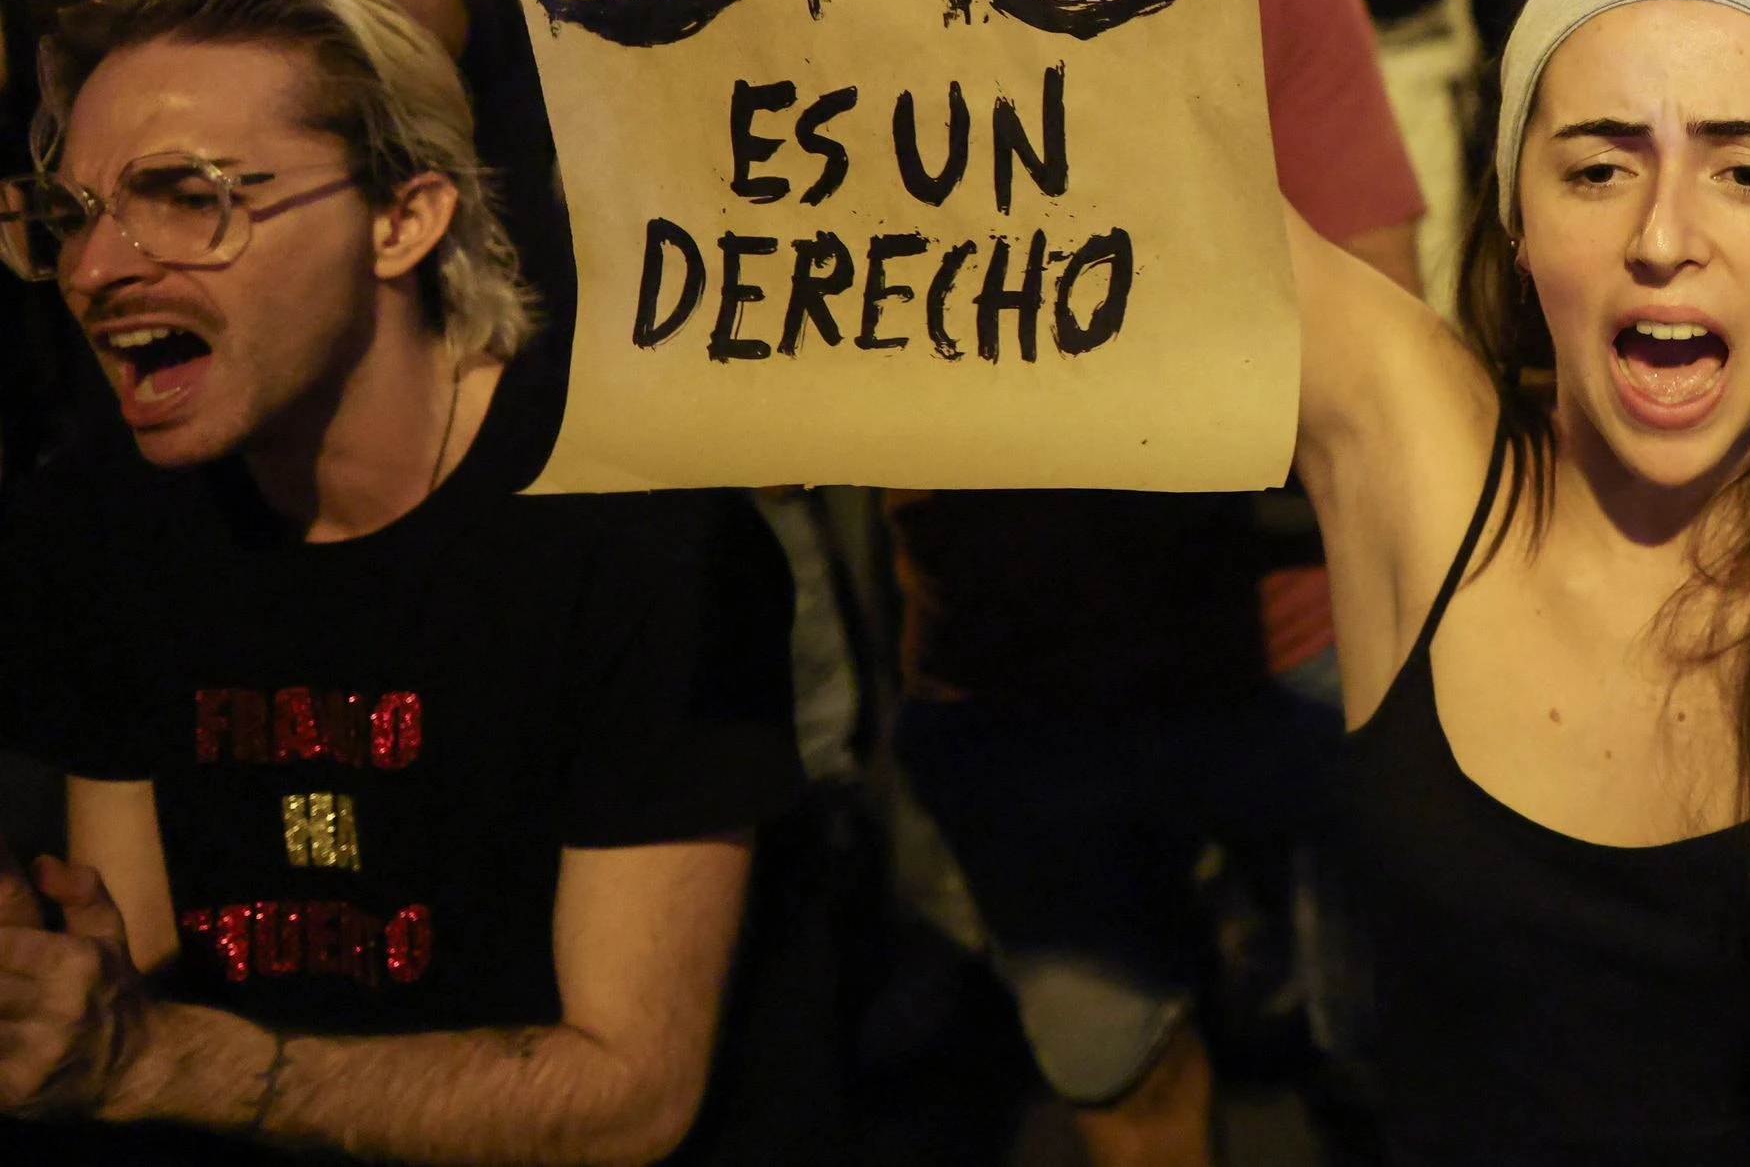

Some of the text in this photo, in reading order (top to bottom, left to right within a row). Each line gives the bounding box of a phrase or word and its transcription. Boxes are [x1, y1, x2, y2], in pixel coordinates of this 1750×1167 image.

[729, 59, 1070, 216] ES UN
[631, 216, 1135, 365] DERECHO
